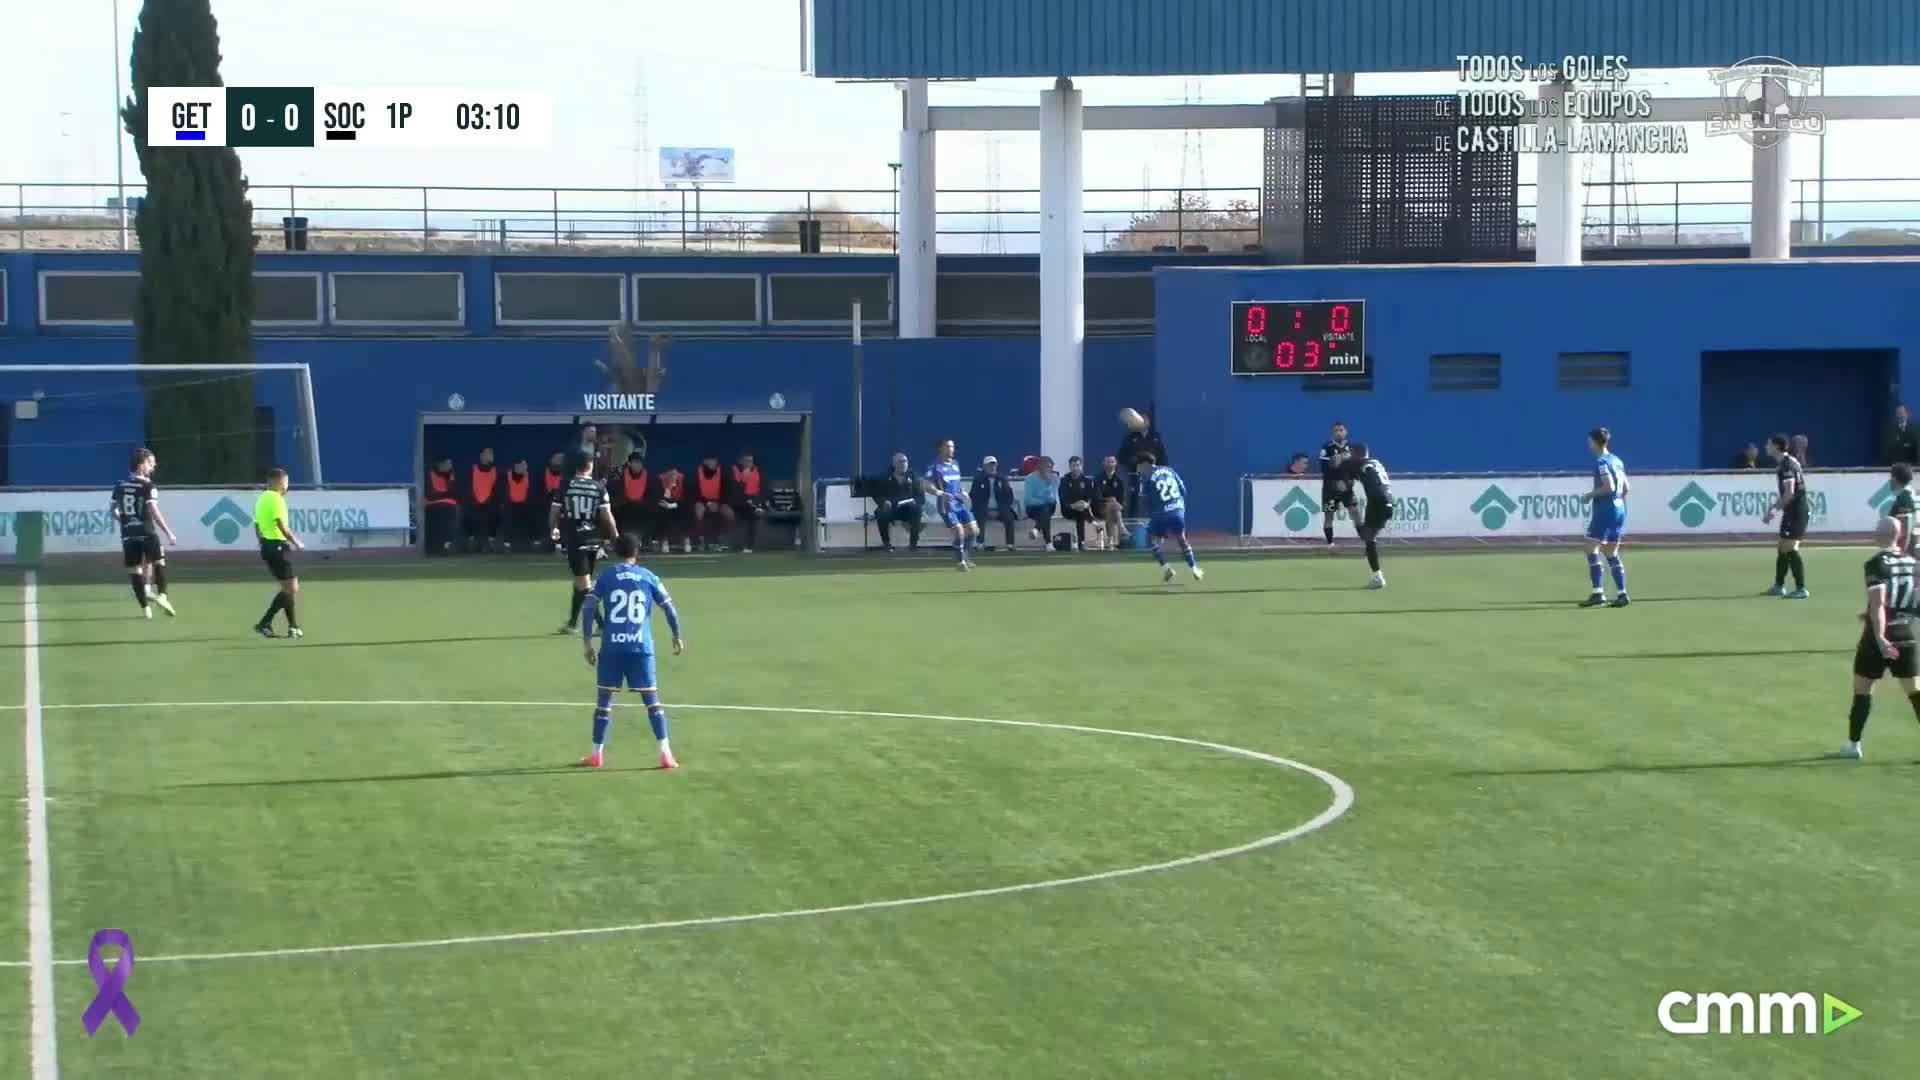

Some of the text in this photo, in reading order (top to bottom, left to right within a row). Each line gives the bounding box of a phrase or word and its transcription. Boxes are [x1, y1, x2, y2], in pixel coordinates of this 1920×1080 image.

[1247, 305, 1266, 333] 0
[1331, 304, 1350, 332] 0
[1329, 352, 1360, 365] min
[583, 393, 655, 411] VISITANTE
[609, 588, 646, 624] 26
